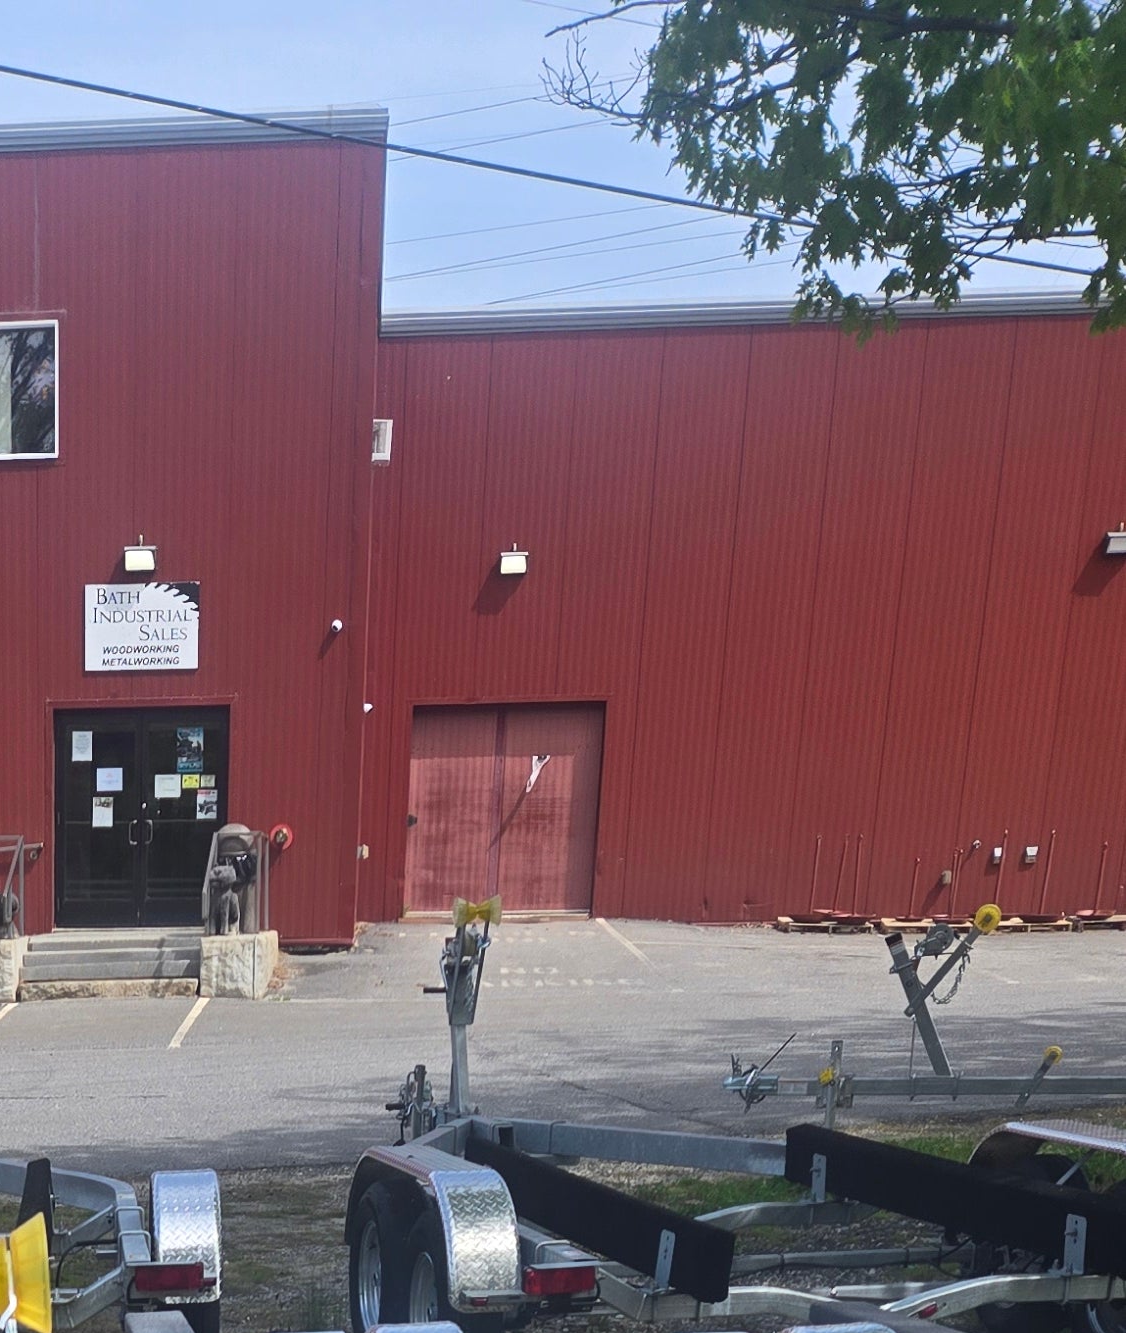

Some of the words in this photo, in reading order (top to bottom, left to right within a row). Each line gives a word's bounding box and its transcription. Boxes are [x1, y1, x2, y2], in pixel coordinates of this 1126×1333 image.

[96, 588, 140, 605] BATH
[93, 608, 192, 624] INDUSTRIAL
[139, 624, 188, 641] SALES
[103, 644, 180, 655] WOODWORKING
[102, 656, 180, 667] METALWORKING
